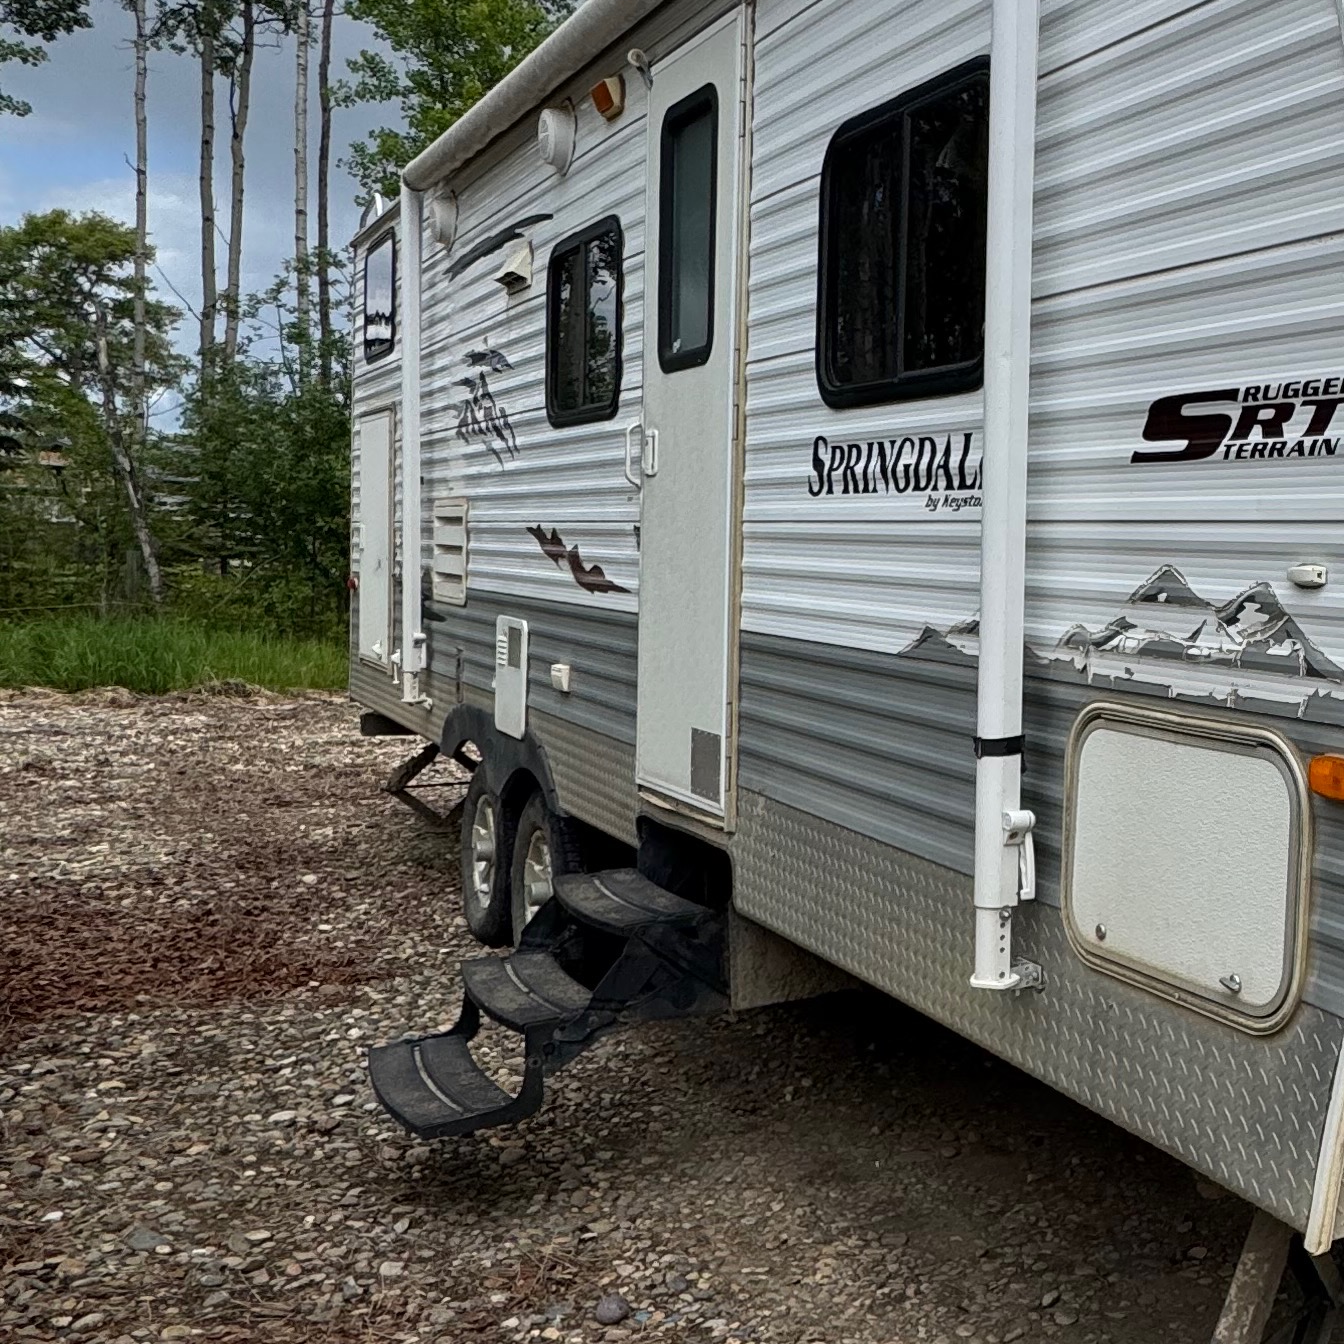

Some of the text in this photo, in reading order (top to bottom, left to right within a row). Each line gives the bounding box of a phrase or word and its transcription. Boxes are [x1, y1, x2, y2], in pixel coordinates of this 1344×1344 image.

[1222, 437, 1341, 461] TERRAIN
[808, 432, 983, 497] SPRINGDAL
[925, 494, 983, 512] by Keysto
